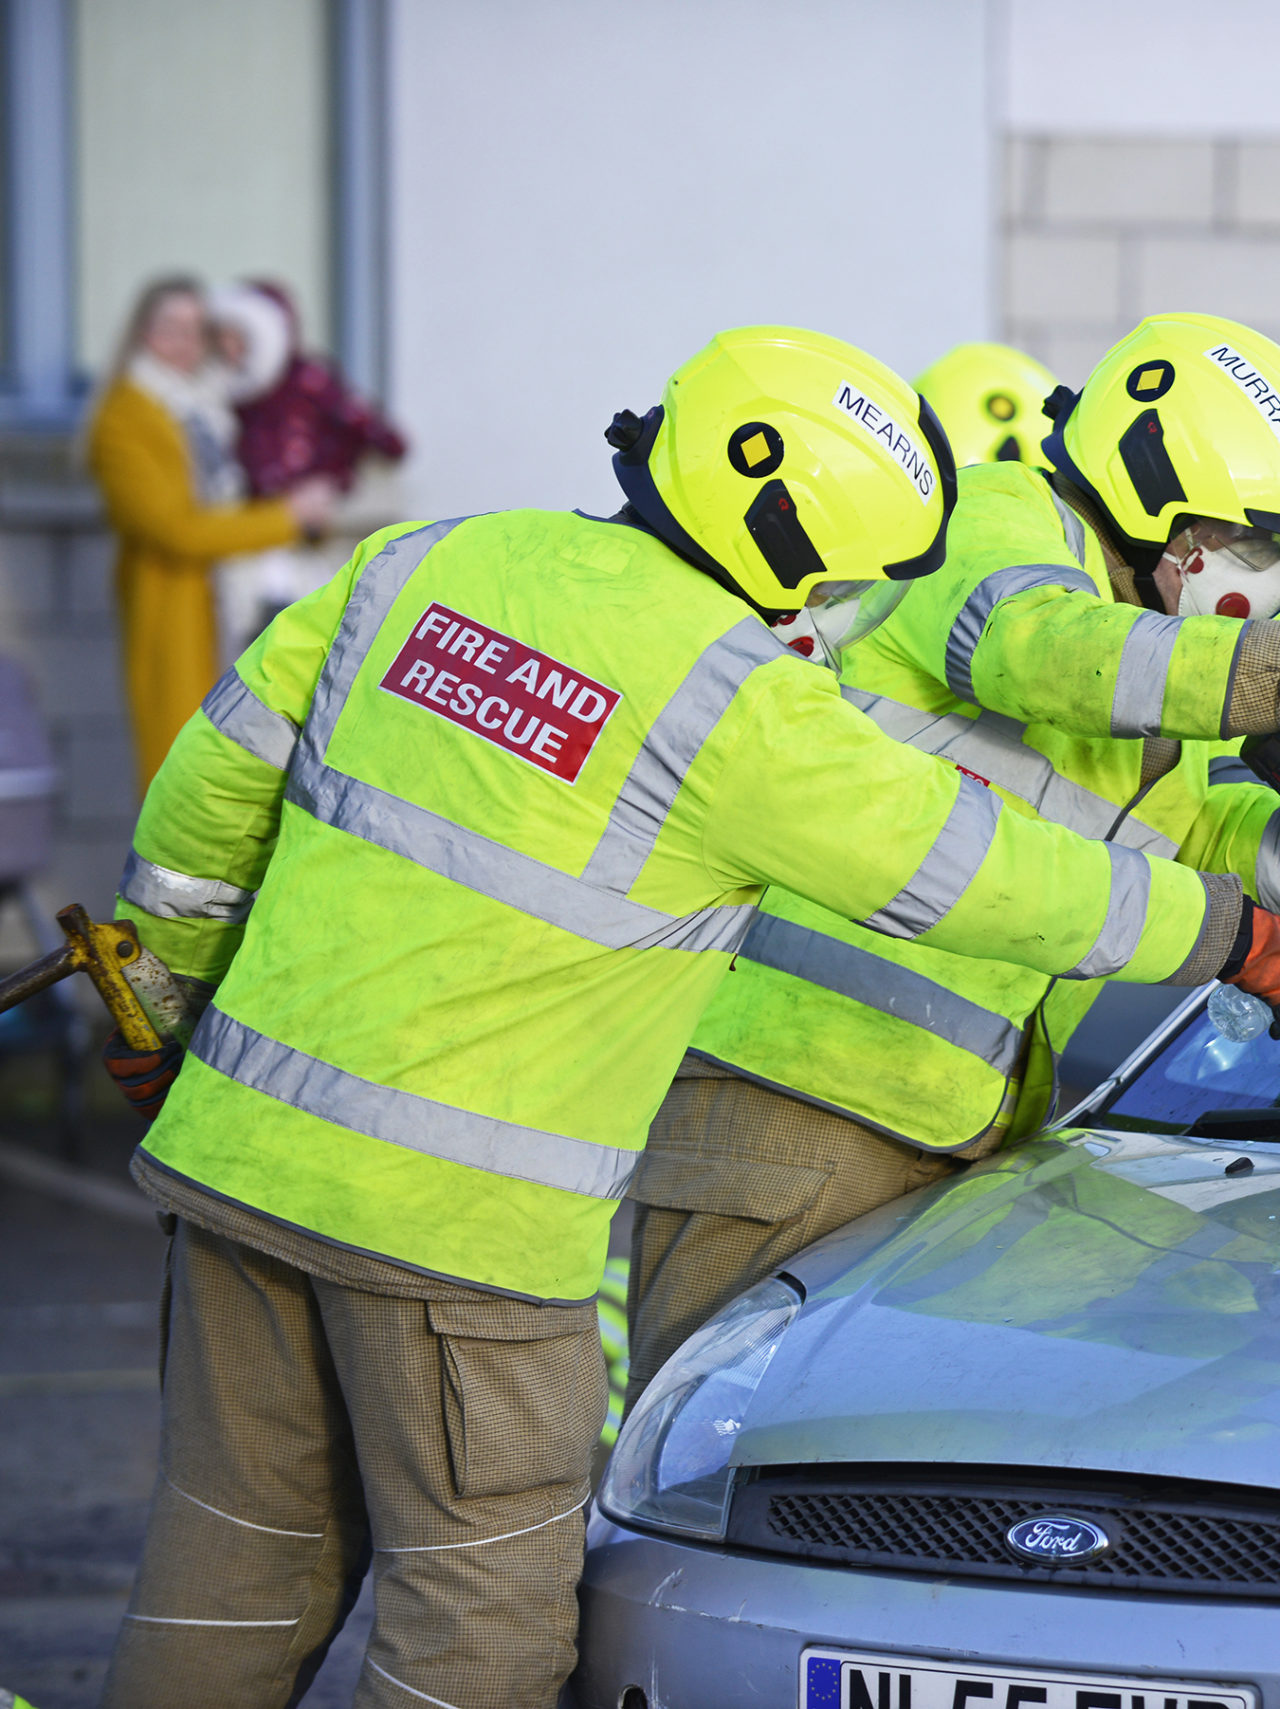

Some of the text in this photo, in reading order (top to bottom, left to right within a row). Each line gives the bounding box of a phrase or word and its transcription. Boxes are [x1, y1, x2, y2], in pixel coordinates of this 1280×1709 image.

[838, 386, 933, 496] MEARNS
[400, 659, 569, 763] RESCUE
[415, 611, 607, 723] FIRE AND
[1025, 1521, 1082, 1552] Ford
